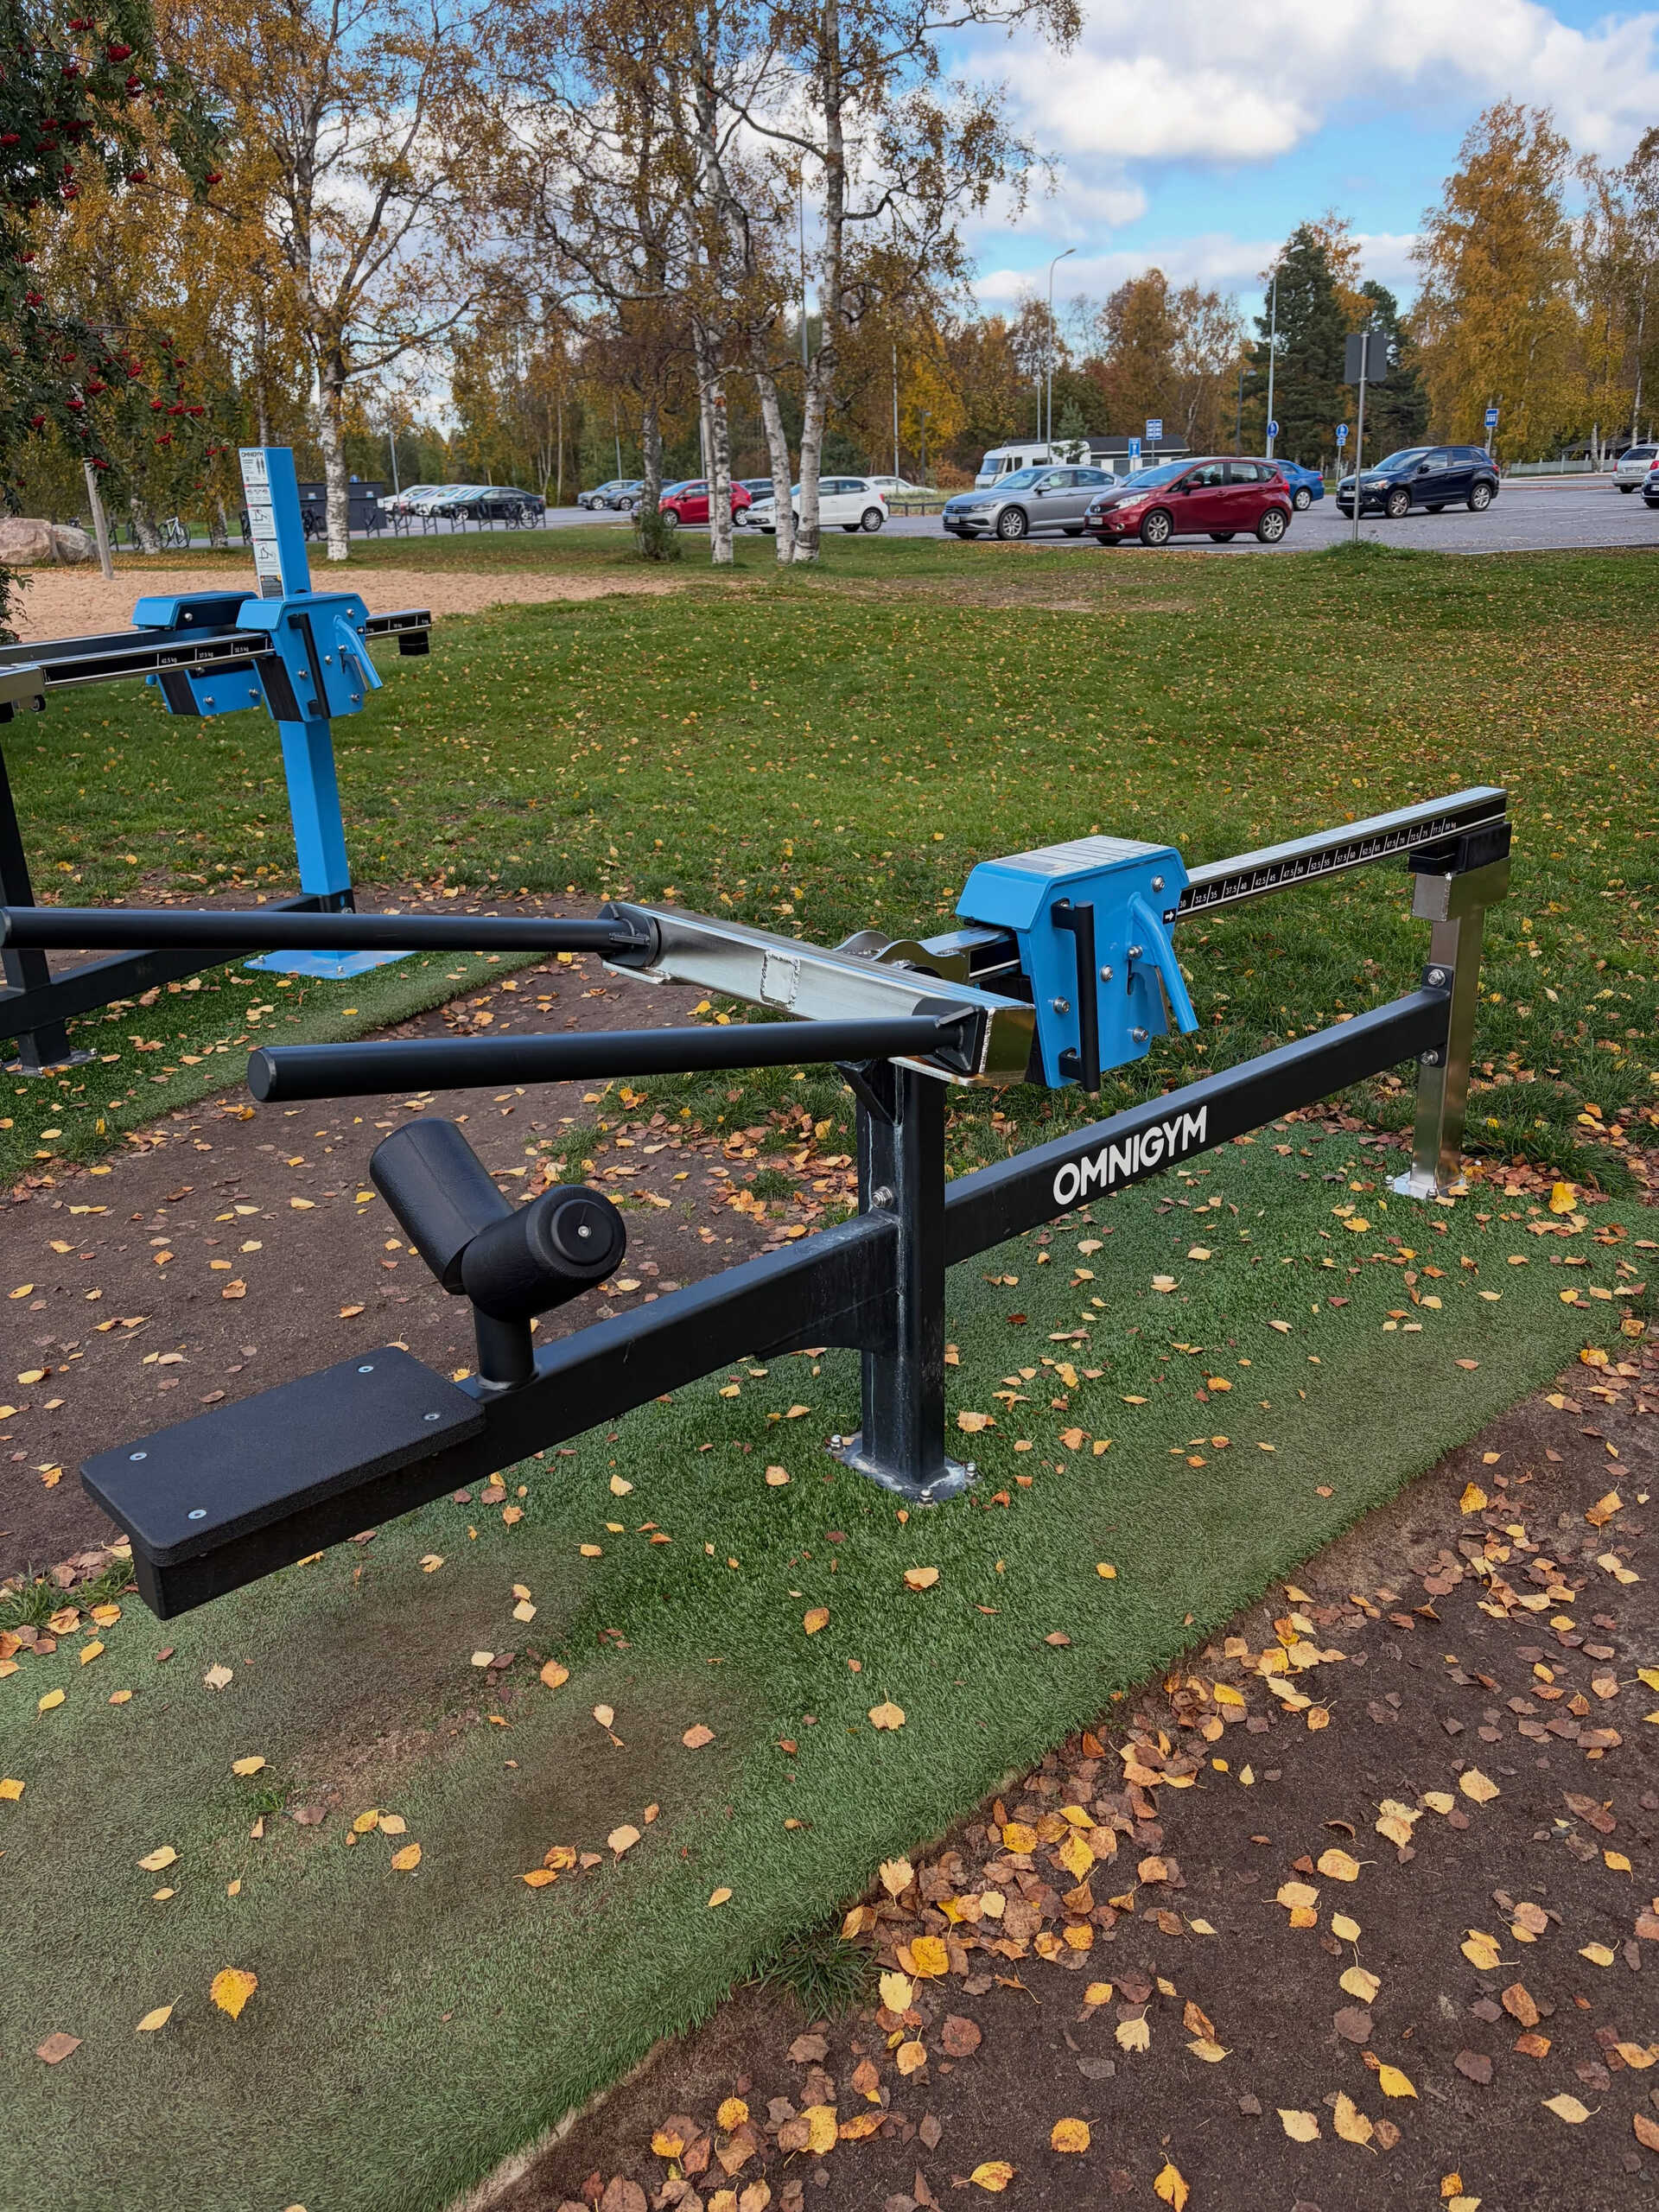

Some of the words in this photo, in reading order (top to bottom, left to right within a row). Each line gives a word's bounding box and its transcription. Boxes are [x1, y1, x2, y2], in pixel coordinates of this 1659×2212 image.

[1195, 893, 1207, 904] 32.5
[1210, 891, 1217, 899] 35
[1225, 885, 1237, 895] 37.5
[1255, 878, 1267, 887] 42.5
[1269, 874, 1276, 882] 45
[1283, 868, 1294, 878] 47.5
[1311, 861, 1321, 871] 52.5
[1337, 854, 1347, 863] 57.5
[1362, 847, 1372, 856] 62.5
[1052, 1105, 1207, 1205] OMNIGYM
